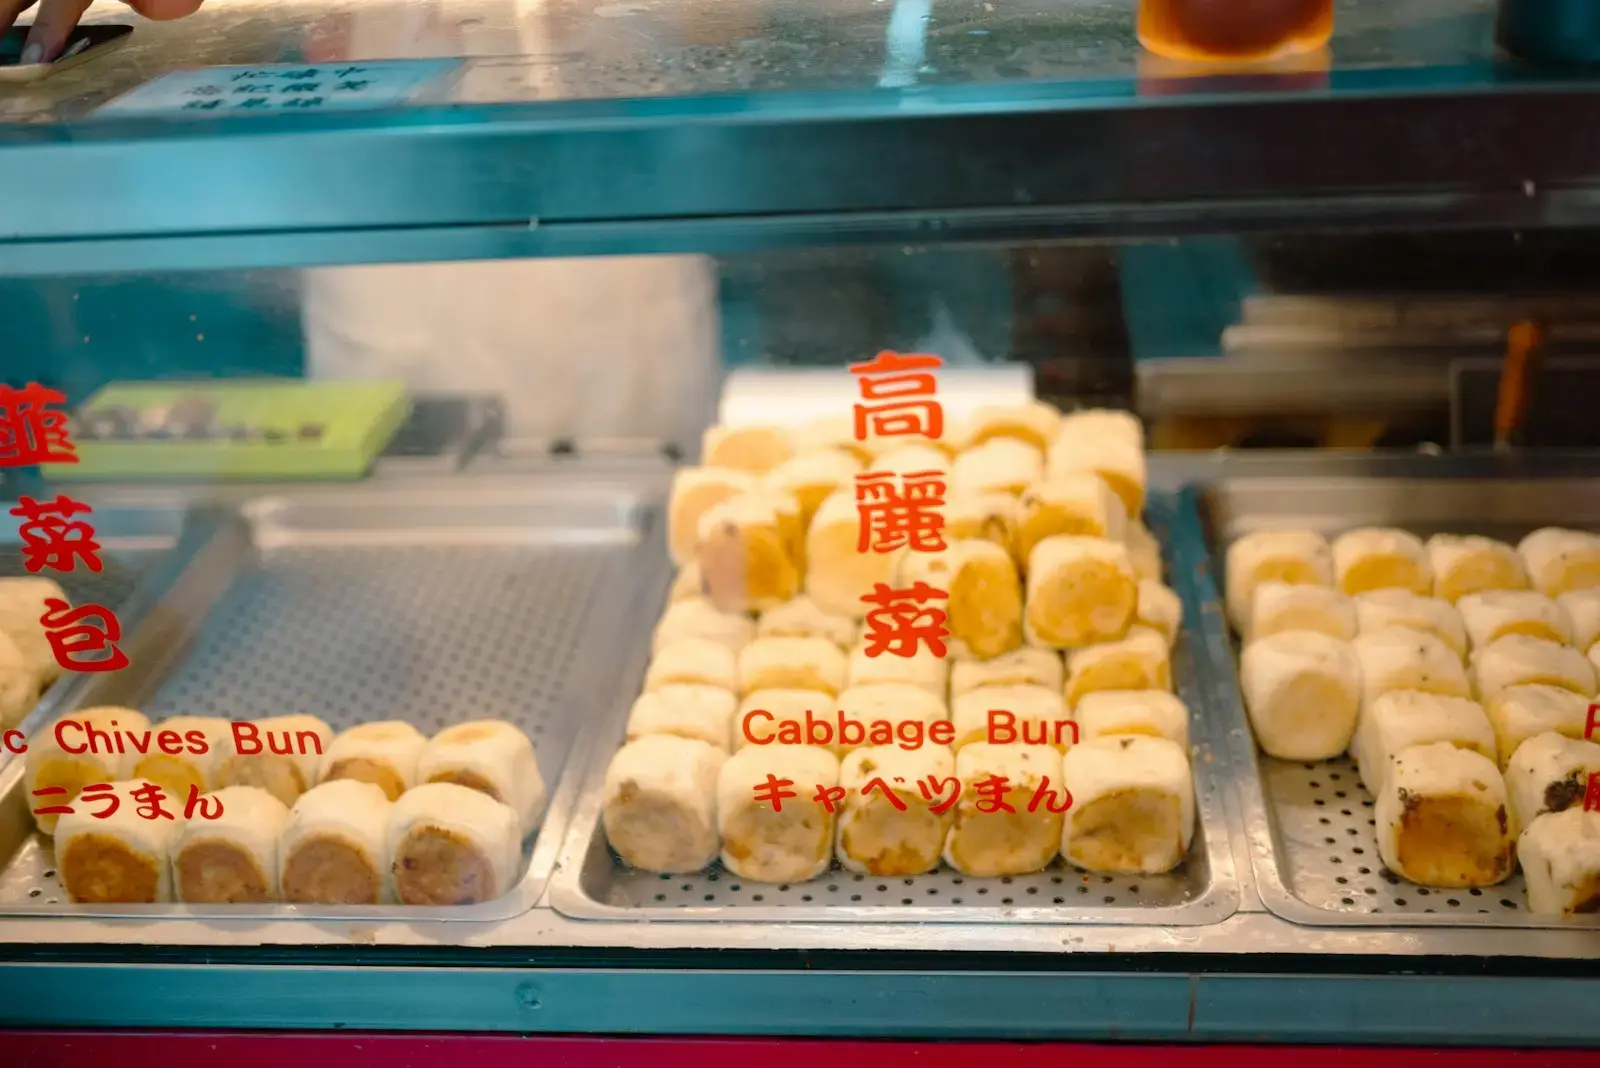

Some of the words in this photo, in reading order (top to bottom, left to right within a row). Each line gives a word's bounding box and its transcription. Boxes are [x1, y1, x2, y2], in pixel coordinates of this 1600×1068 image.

[850, 351, 950, 659] 高麗菜
[53, 719, 210, 756] Chives
[231, 721, 324, 756] Bun
[742, 709, 956, 751] Cabbage
[988, 710, 1080, 745] Bun
